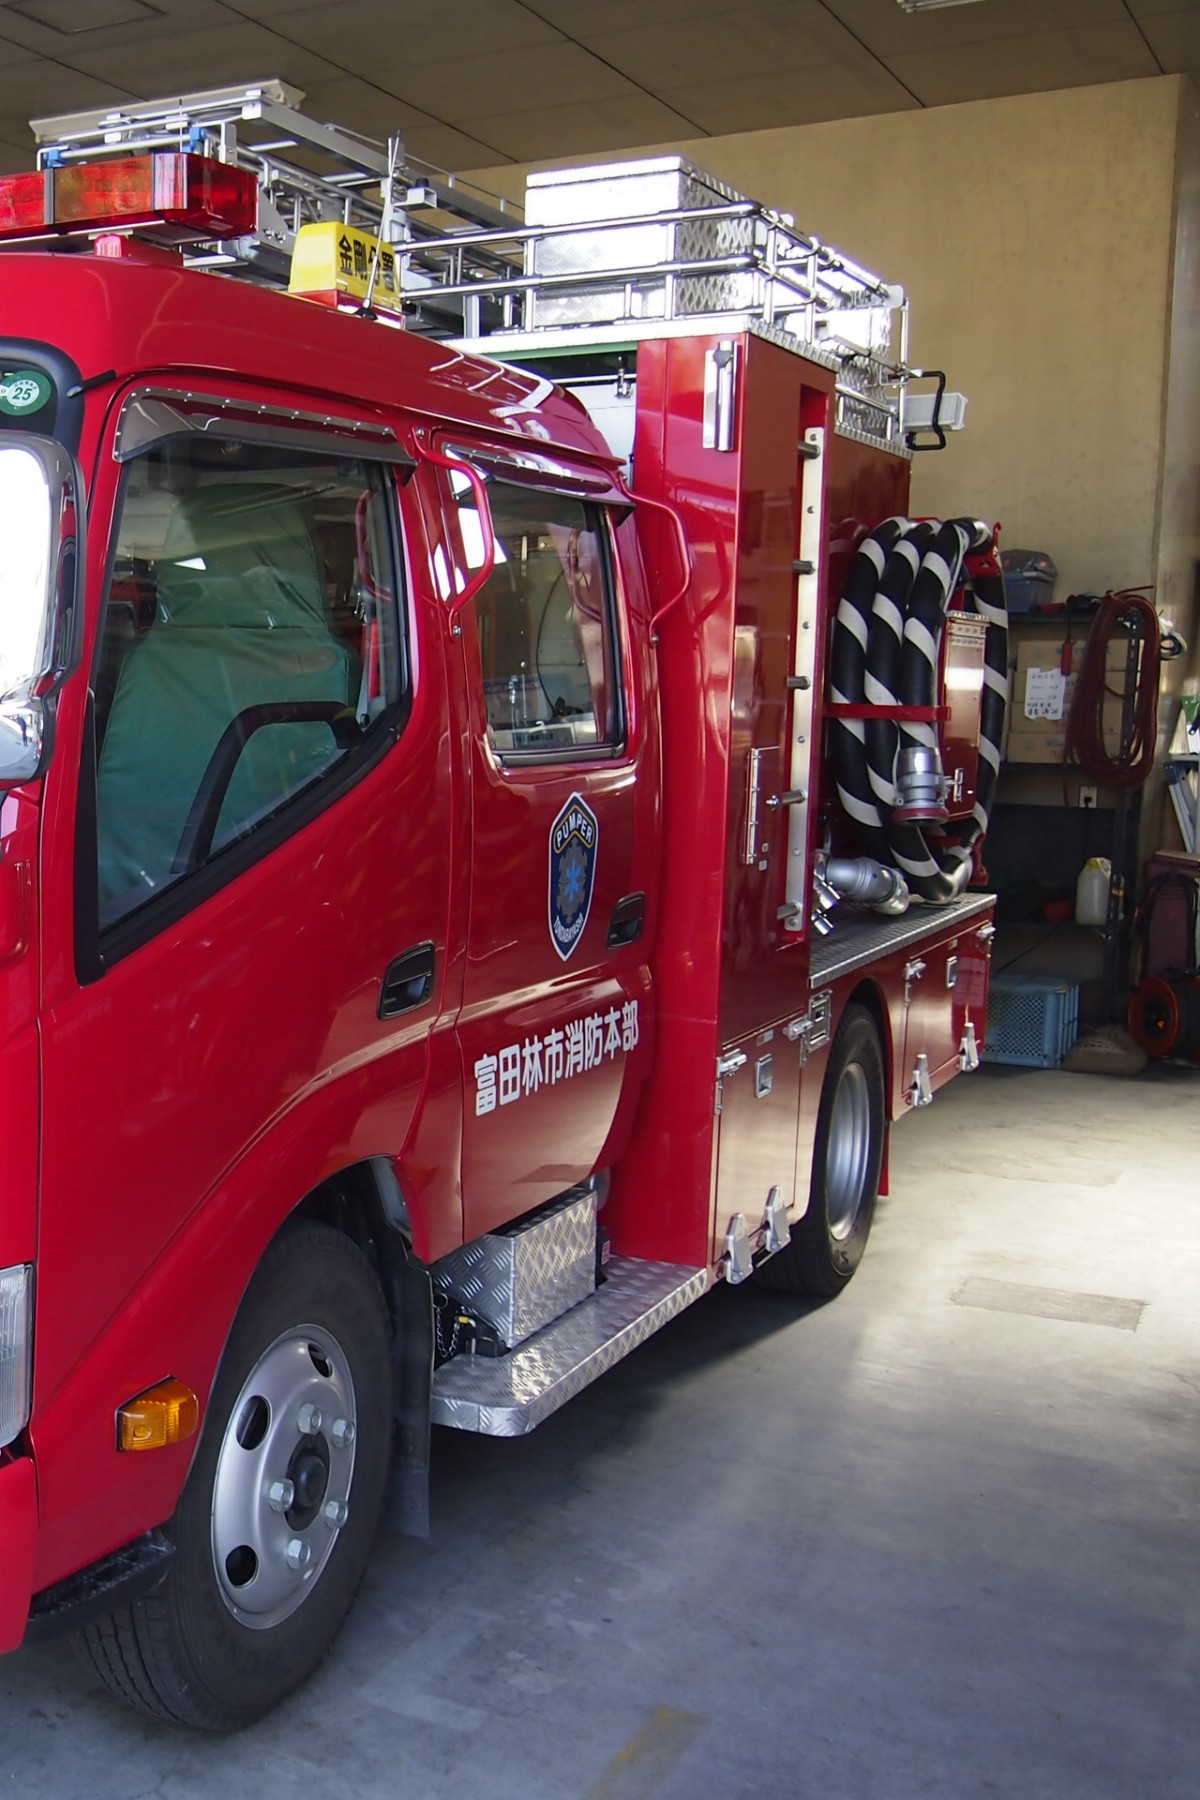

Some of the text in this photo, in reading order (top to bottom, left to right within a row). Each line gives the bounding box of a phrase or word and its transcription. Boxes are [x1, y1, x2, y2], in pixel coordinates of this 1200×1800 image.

[12, 387, 32, 401] 25
[556, 812, 593, 848] PUMPER
[474, 1000, 639, 1117] 富田林市消防本部
